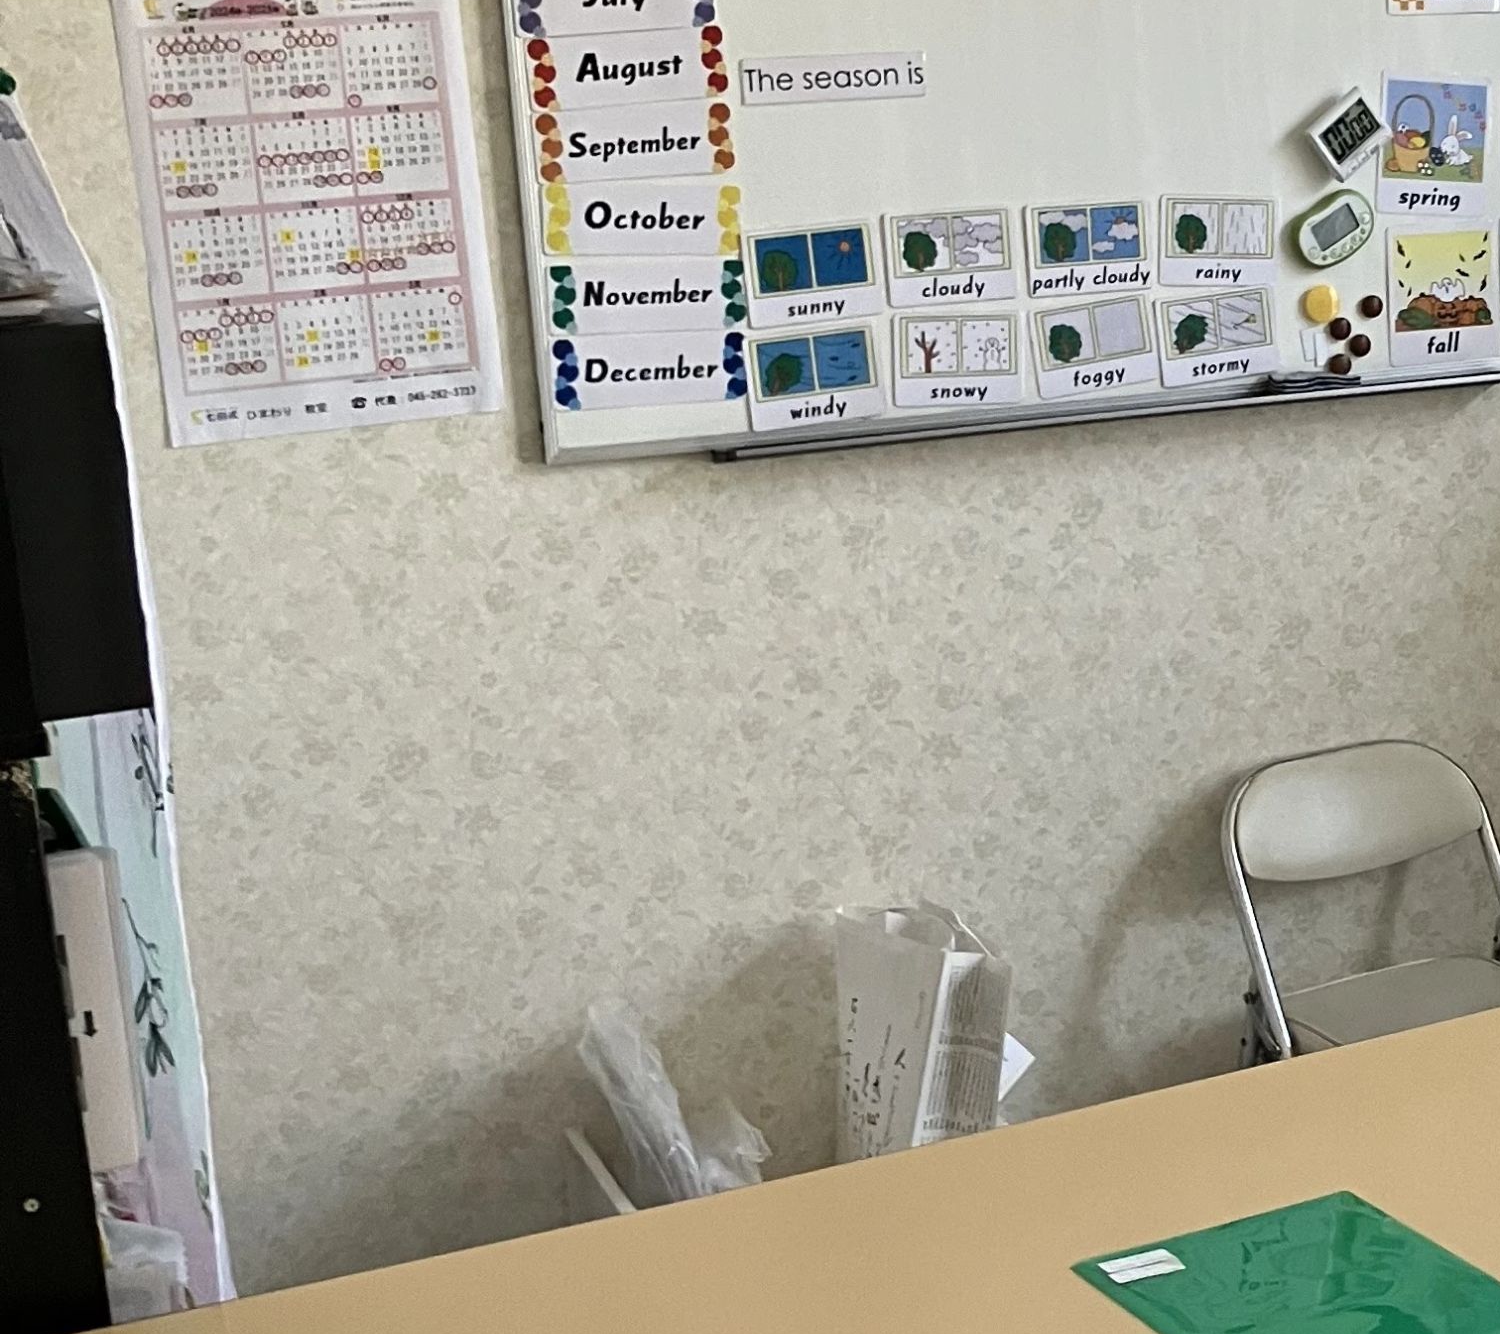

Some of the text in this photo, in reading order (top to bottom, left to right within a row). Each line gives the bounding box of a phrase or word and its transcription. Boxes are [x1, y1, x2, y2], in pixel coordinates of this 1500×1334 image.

[575, 52, 683, 86] August
[743, 60, 924, 93] The season is
[568, 125, 701, 163] September
[1398, 187, 1461, 212] spring
[584, 200, 706, 230] October
[922, 274, 985, 298] cloudy
[1032, 262, 1151, 295] partly cloudy
[1195, 268, 1242, 283] rainy
[583, 277, 713, 307] November
[788, 299, 845, 317] sunny
[1427, 330, 1460, 355] fall
[584, 358, 719, 384] December
[1073, 367, 1125, 388] foggy
[1192, 358, 1250, 380] stormy
[930, 386, 988, 402] snowy
[789, 394, 847, 420] windy
